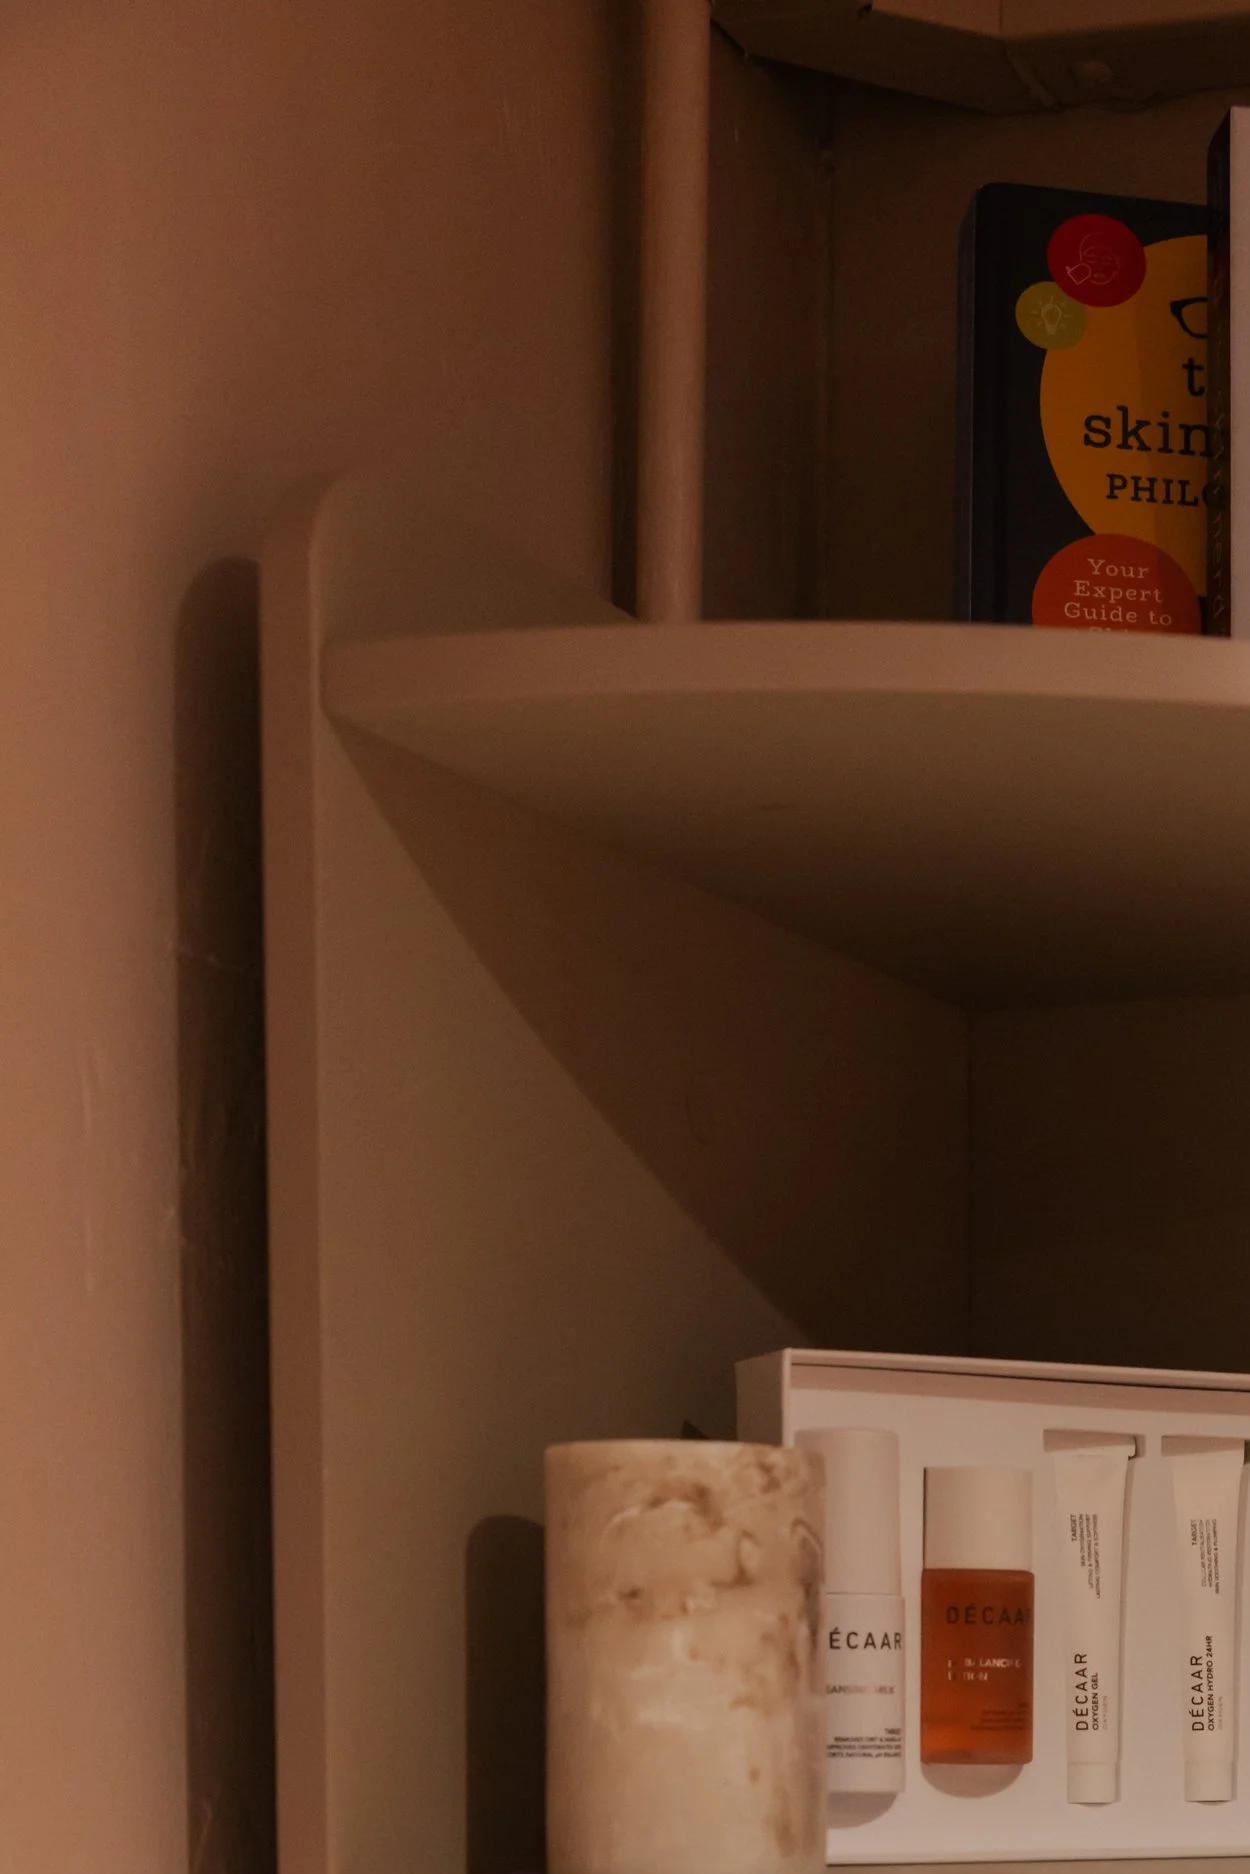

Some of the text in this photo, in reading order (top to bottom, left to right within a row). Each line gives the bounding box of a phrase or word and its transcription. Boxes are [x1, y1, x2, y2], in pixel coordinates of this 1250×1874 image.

[1083, 405, 1213, 458] skin
[1087, 558, 1149, 579] Your
[1074, 579, 1162, 604] Expert
[1064, 601, 1172, 626] Guide to
[829, 1626, 902, 1650] ÉCAAR
[1073, 1653, 1088, 1731] DÉCAAR
[1190, 1655, 1204, 1731] DÉCAAR
[1205, 1635, 1215, 1731] OXYGEN HYDRO 24HR
[1091, 1692, 1099, 1731] OXYGEN
